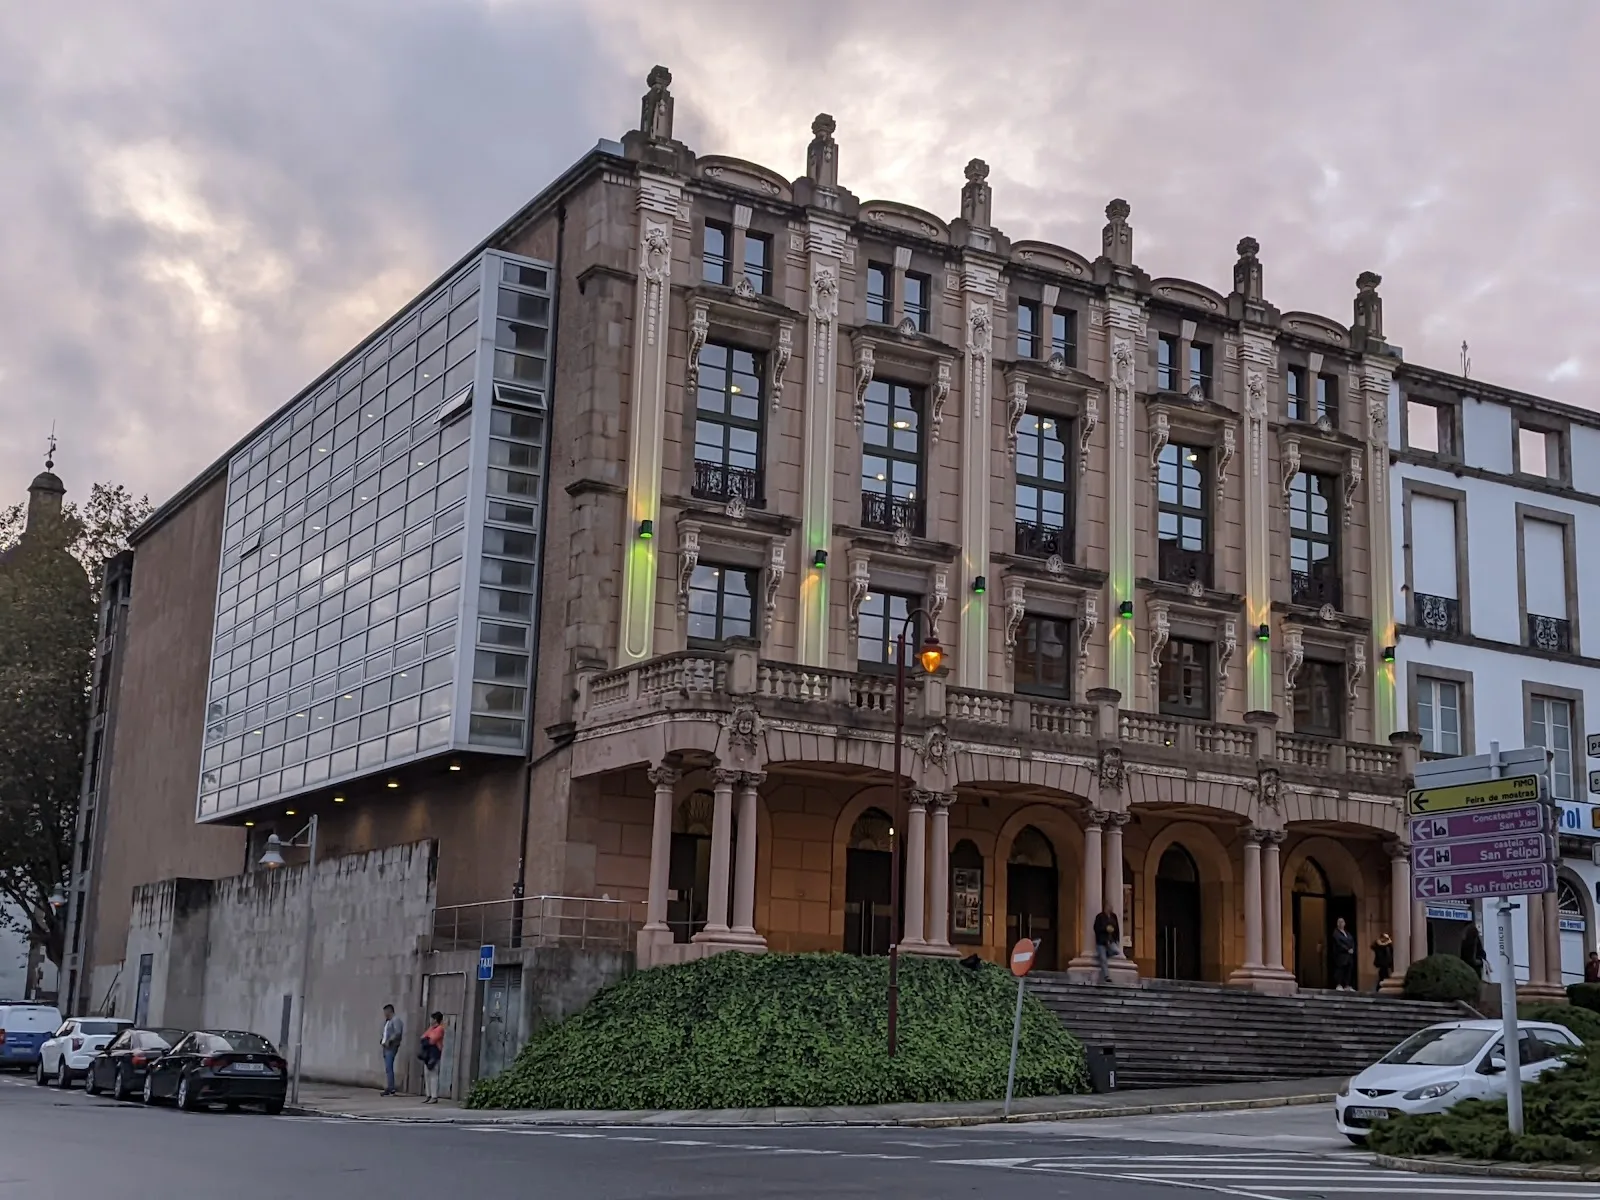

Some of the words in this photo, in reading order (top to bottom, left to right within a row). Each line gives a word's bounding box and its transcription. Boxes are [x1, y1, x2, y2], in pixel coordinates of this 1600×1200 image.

[1465, 796, 1485, 804] Feira
[1502, 790, 1535, 799] mostras
[1472, 810, 1521, 822] Concatedral
[1500, 822, 1515, 830] San
[1480, 850, 1501, 860] San
[1506, 847, 1539, 859] Felipe
[1531, 868, 1540, 876] de
[1465, 883, 1486, 893] San
[1489, 879, 1542, 892] Francisco
[480, 957, 492, 968] TAXI
